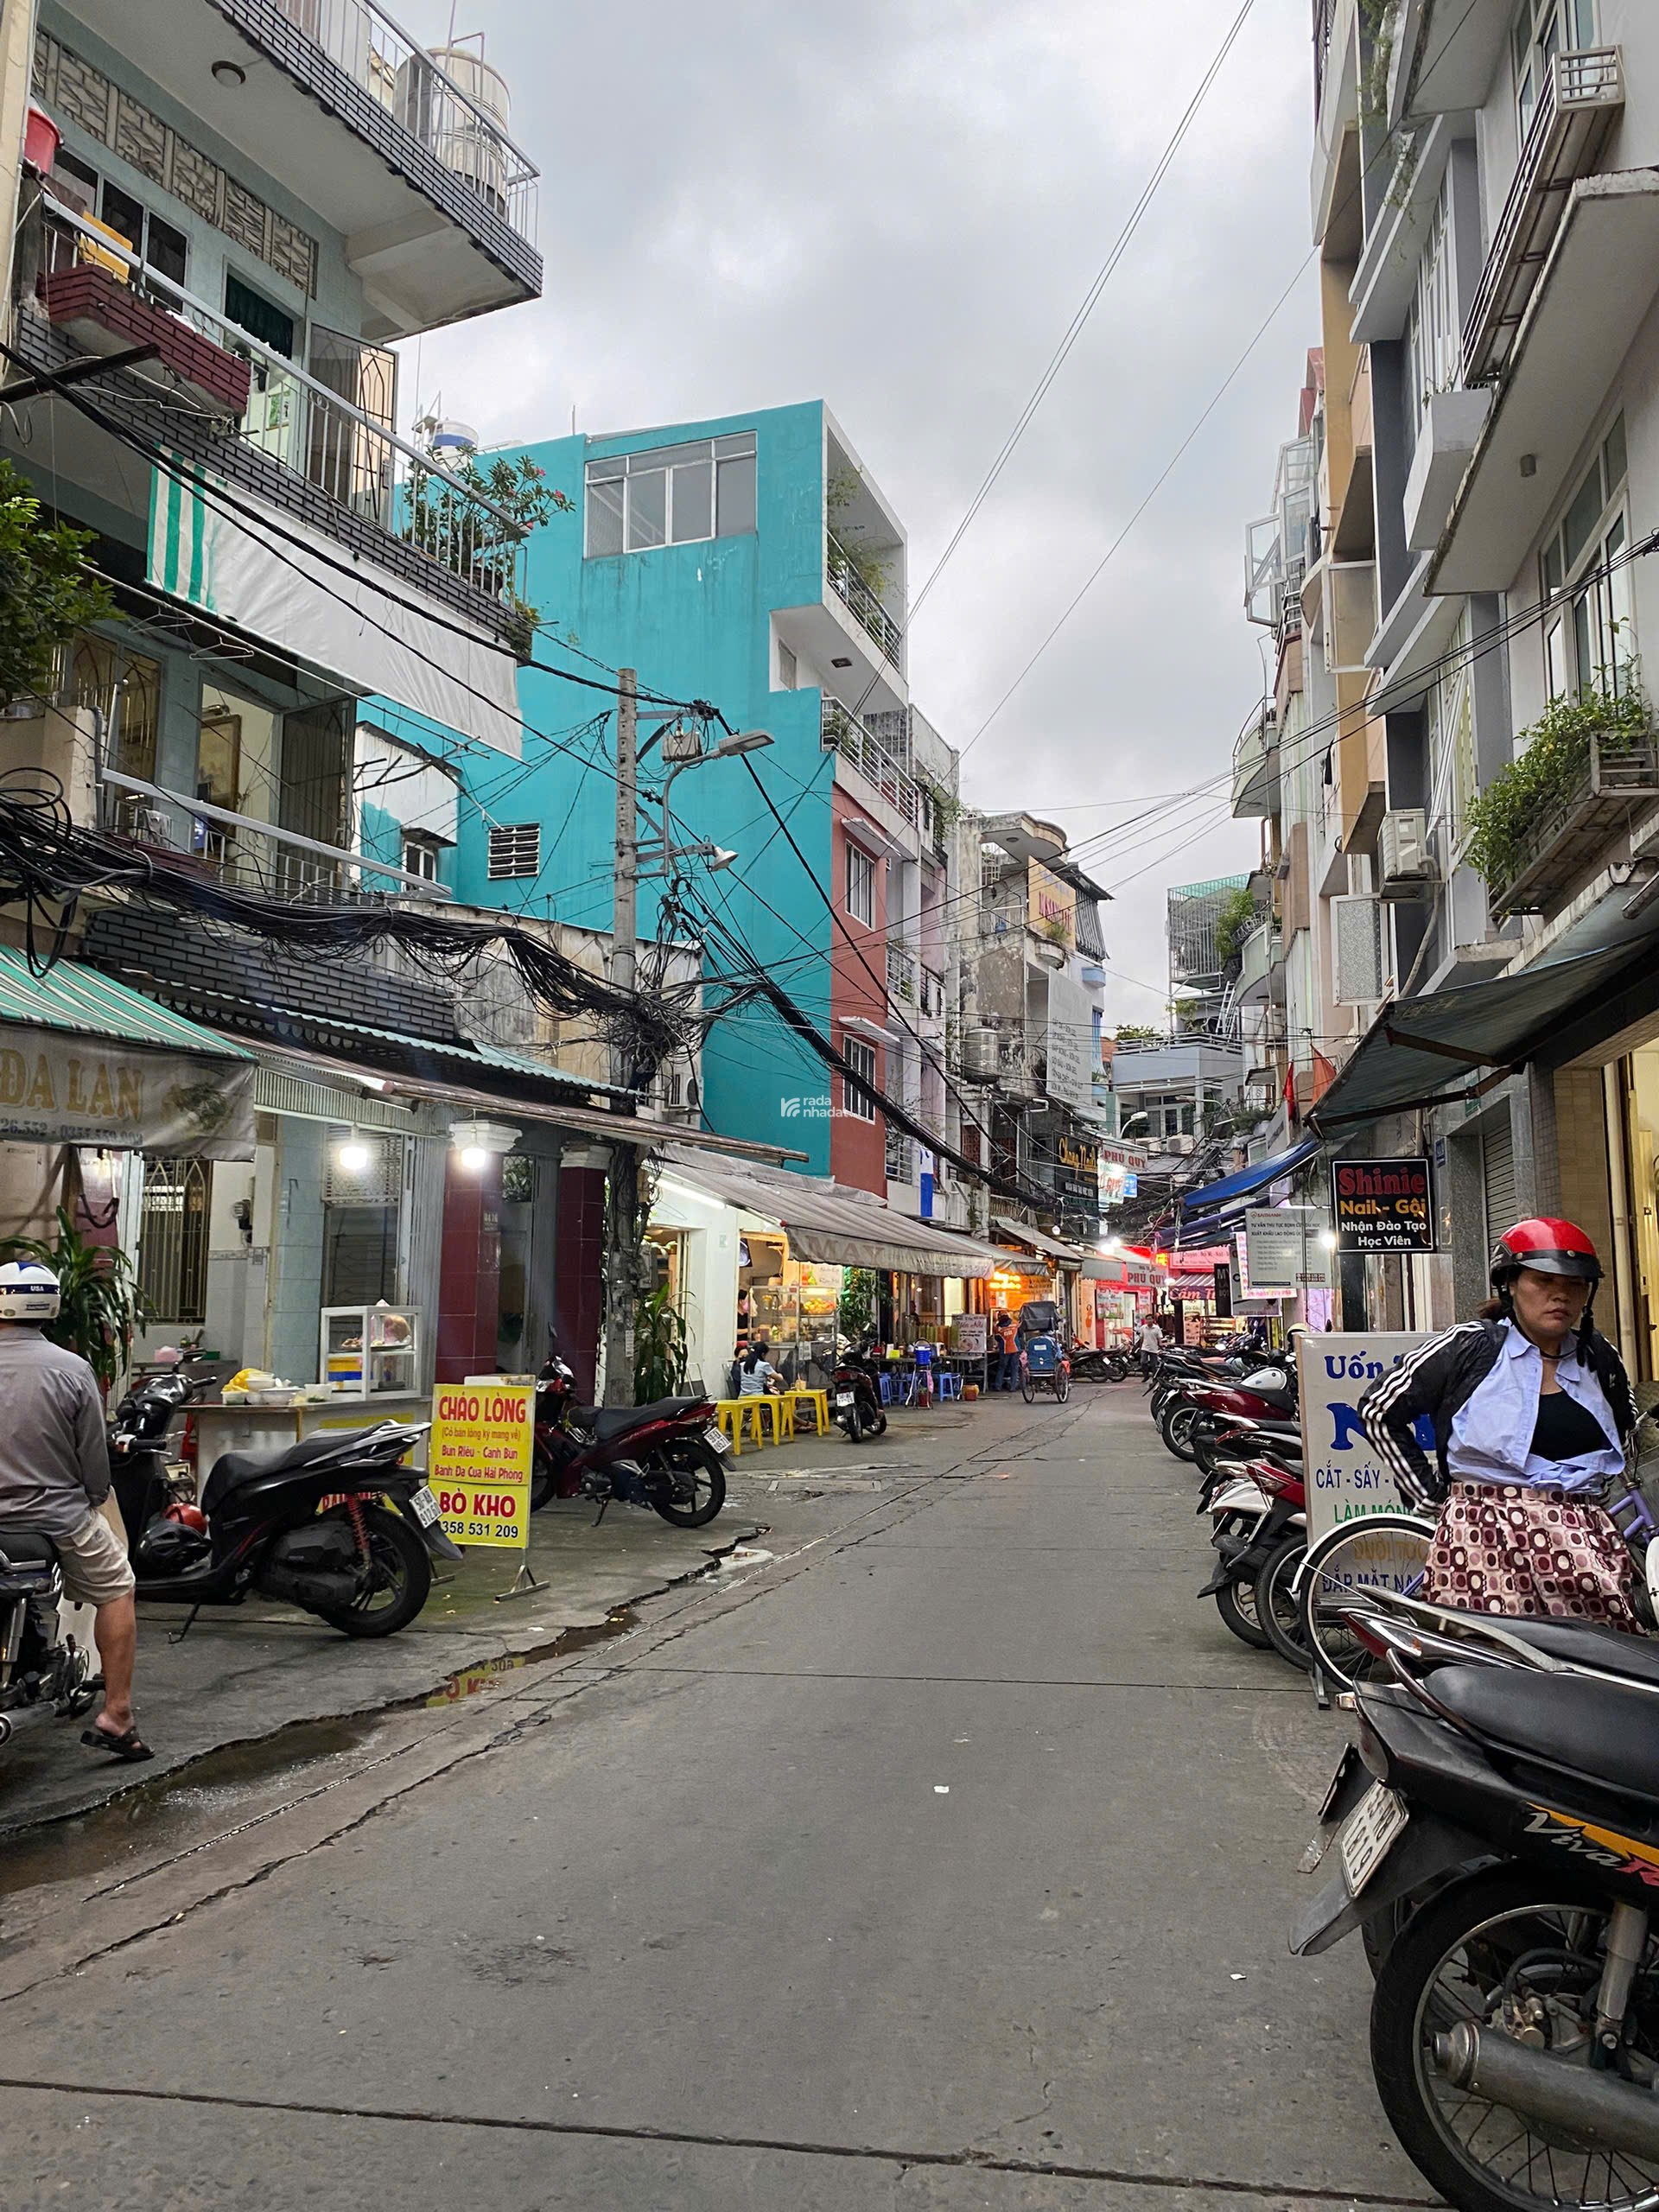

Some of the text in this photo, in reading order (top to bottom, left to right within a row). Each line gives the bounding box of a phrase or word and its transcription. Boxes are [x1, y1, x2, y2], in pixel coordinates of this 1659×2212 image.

[67, 1059, 143, 1122] LAN
[1339, 1167, 1425, 1195] Shinie
[1340, 1199, 1376, 1215] Nail
[1395, 1198, 1426, 1217] Gội
[1341, 1220, 1427, 1233] Nhận Đào Tạo
[1358, 1236, 1411, 1248] Học Viên
[1325, 1351, 1382, 1379] Uốn
[439, 1391, 526, 1423] CHÁO LÒNG
[492, 1431, 509, 1441] mang
[483, 1446, 501, 1459] Canh
[468, 1466, 481, 1478] Cua
[1316, 1460, 1343, 1488] CẮT
[1354, 1461, 1381, 1489] SẤY
[440, 1488, 516, 1518] BÒ KHO
[1334, 1498, 1411, 1523] LÀM MÓN
[439, 1521, 518, 1538] 358 531 209
